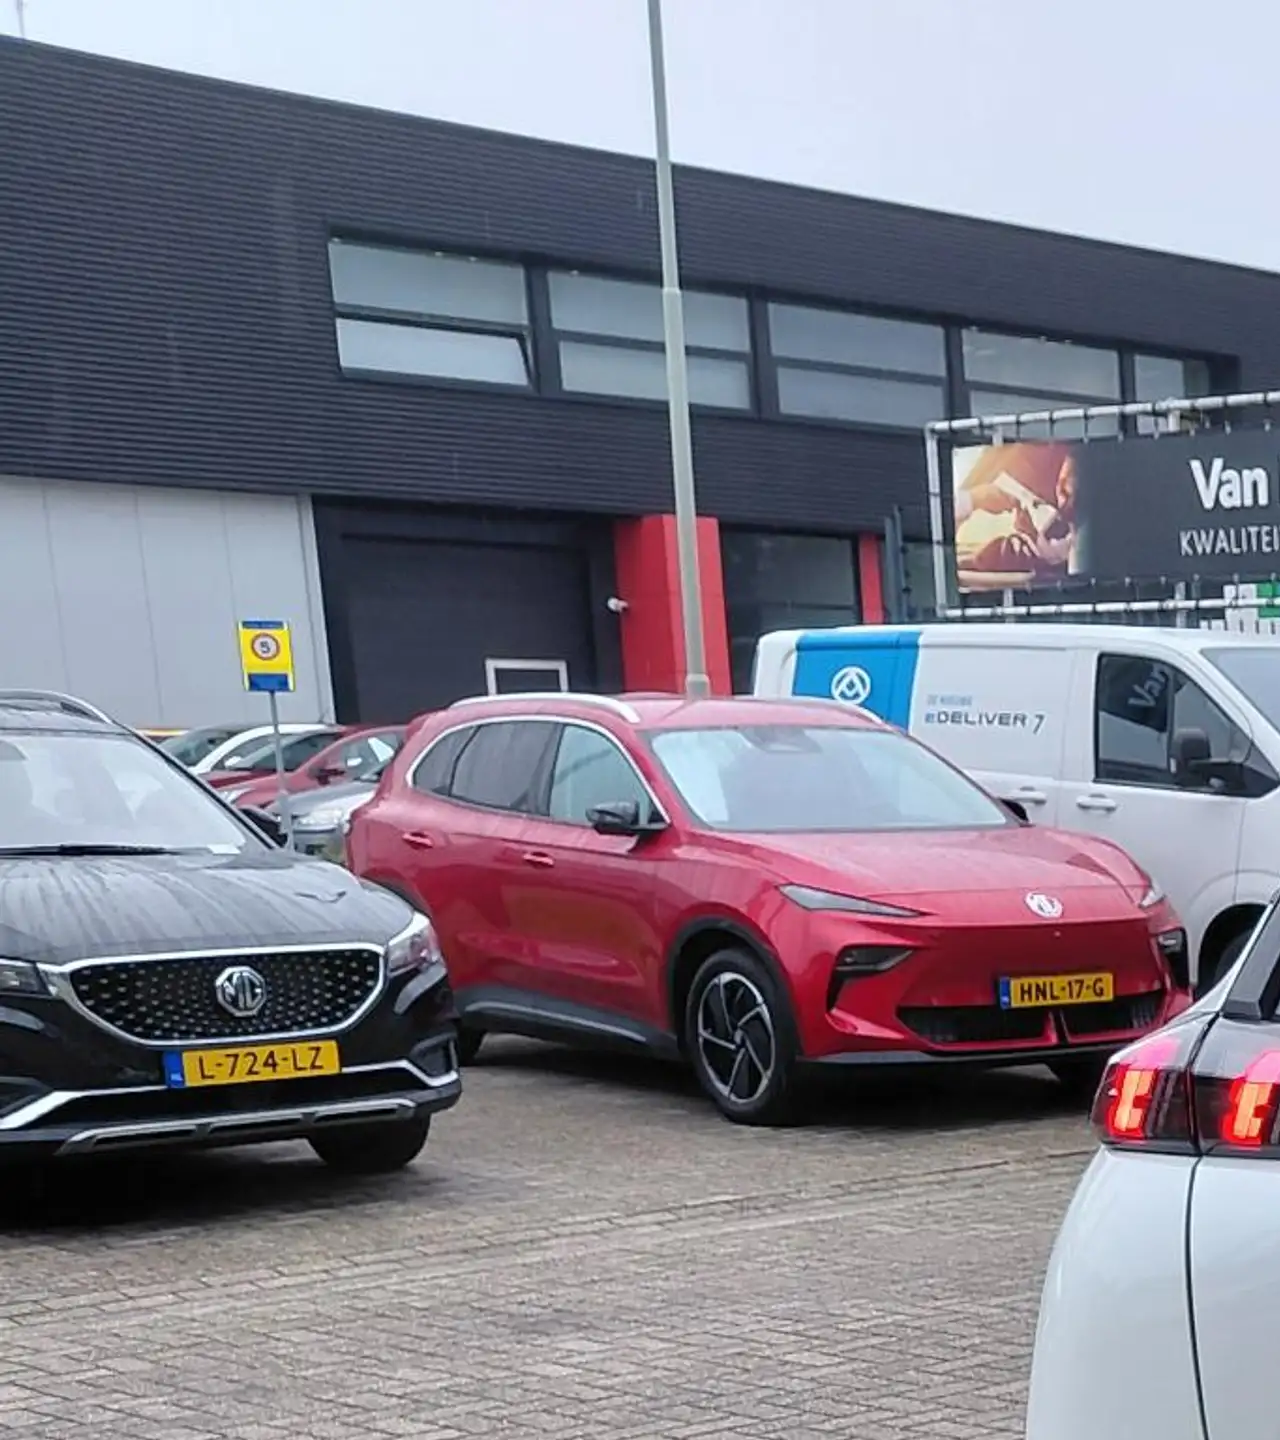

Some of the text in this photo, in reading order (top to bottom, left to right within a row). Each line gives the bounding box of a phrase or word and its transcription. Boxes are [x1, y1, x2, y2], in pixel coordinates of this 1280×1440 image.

[1190, 457, 1268, 509] Van
[1032, 714, 1045, 735] 7
[1020, 977, 1104, 1002] HNL-17-G
[199, 1046, 323, 1080] L-724-LZ
